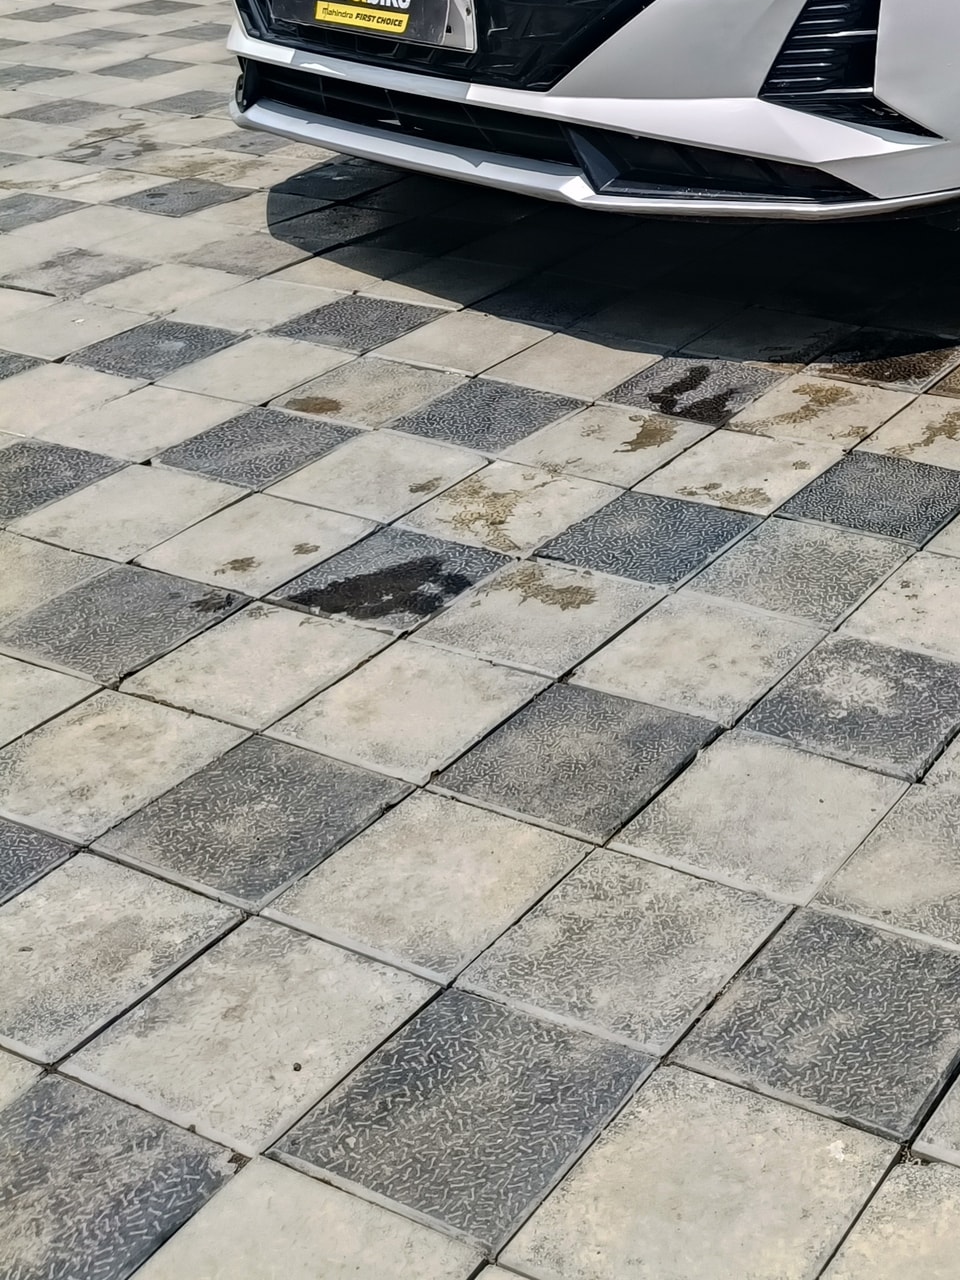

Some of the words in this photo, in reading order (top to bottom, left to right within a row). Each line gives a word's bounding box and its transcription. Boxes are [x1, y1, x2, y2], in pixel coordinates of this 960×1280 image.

[322, 6, 354, 19] Mahindra
[355, 12, 376, 23] FIRST
[376, 15, 403, 27] CHOICE
